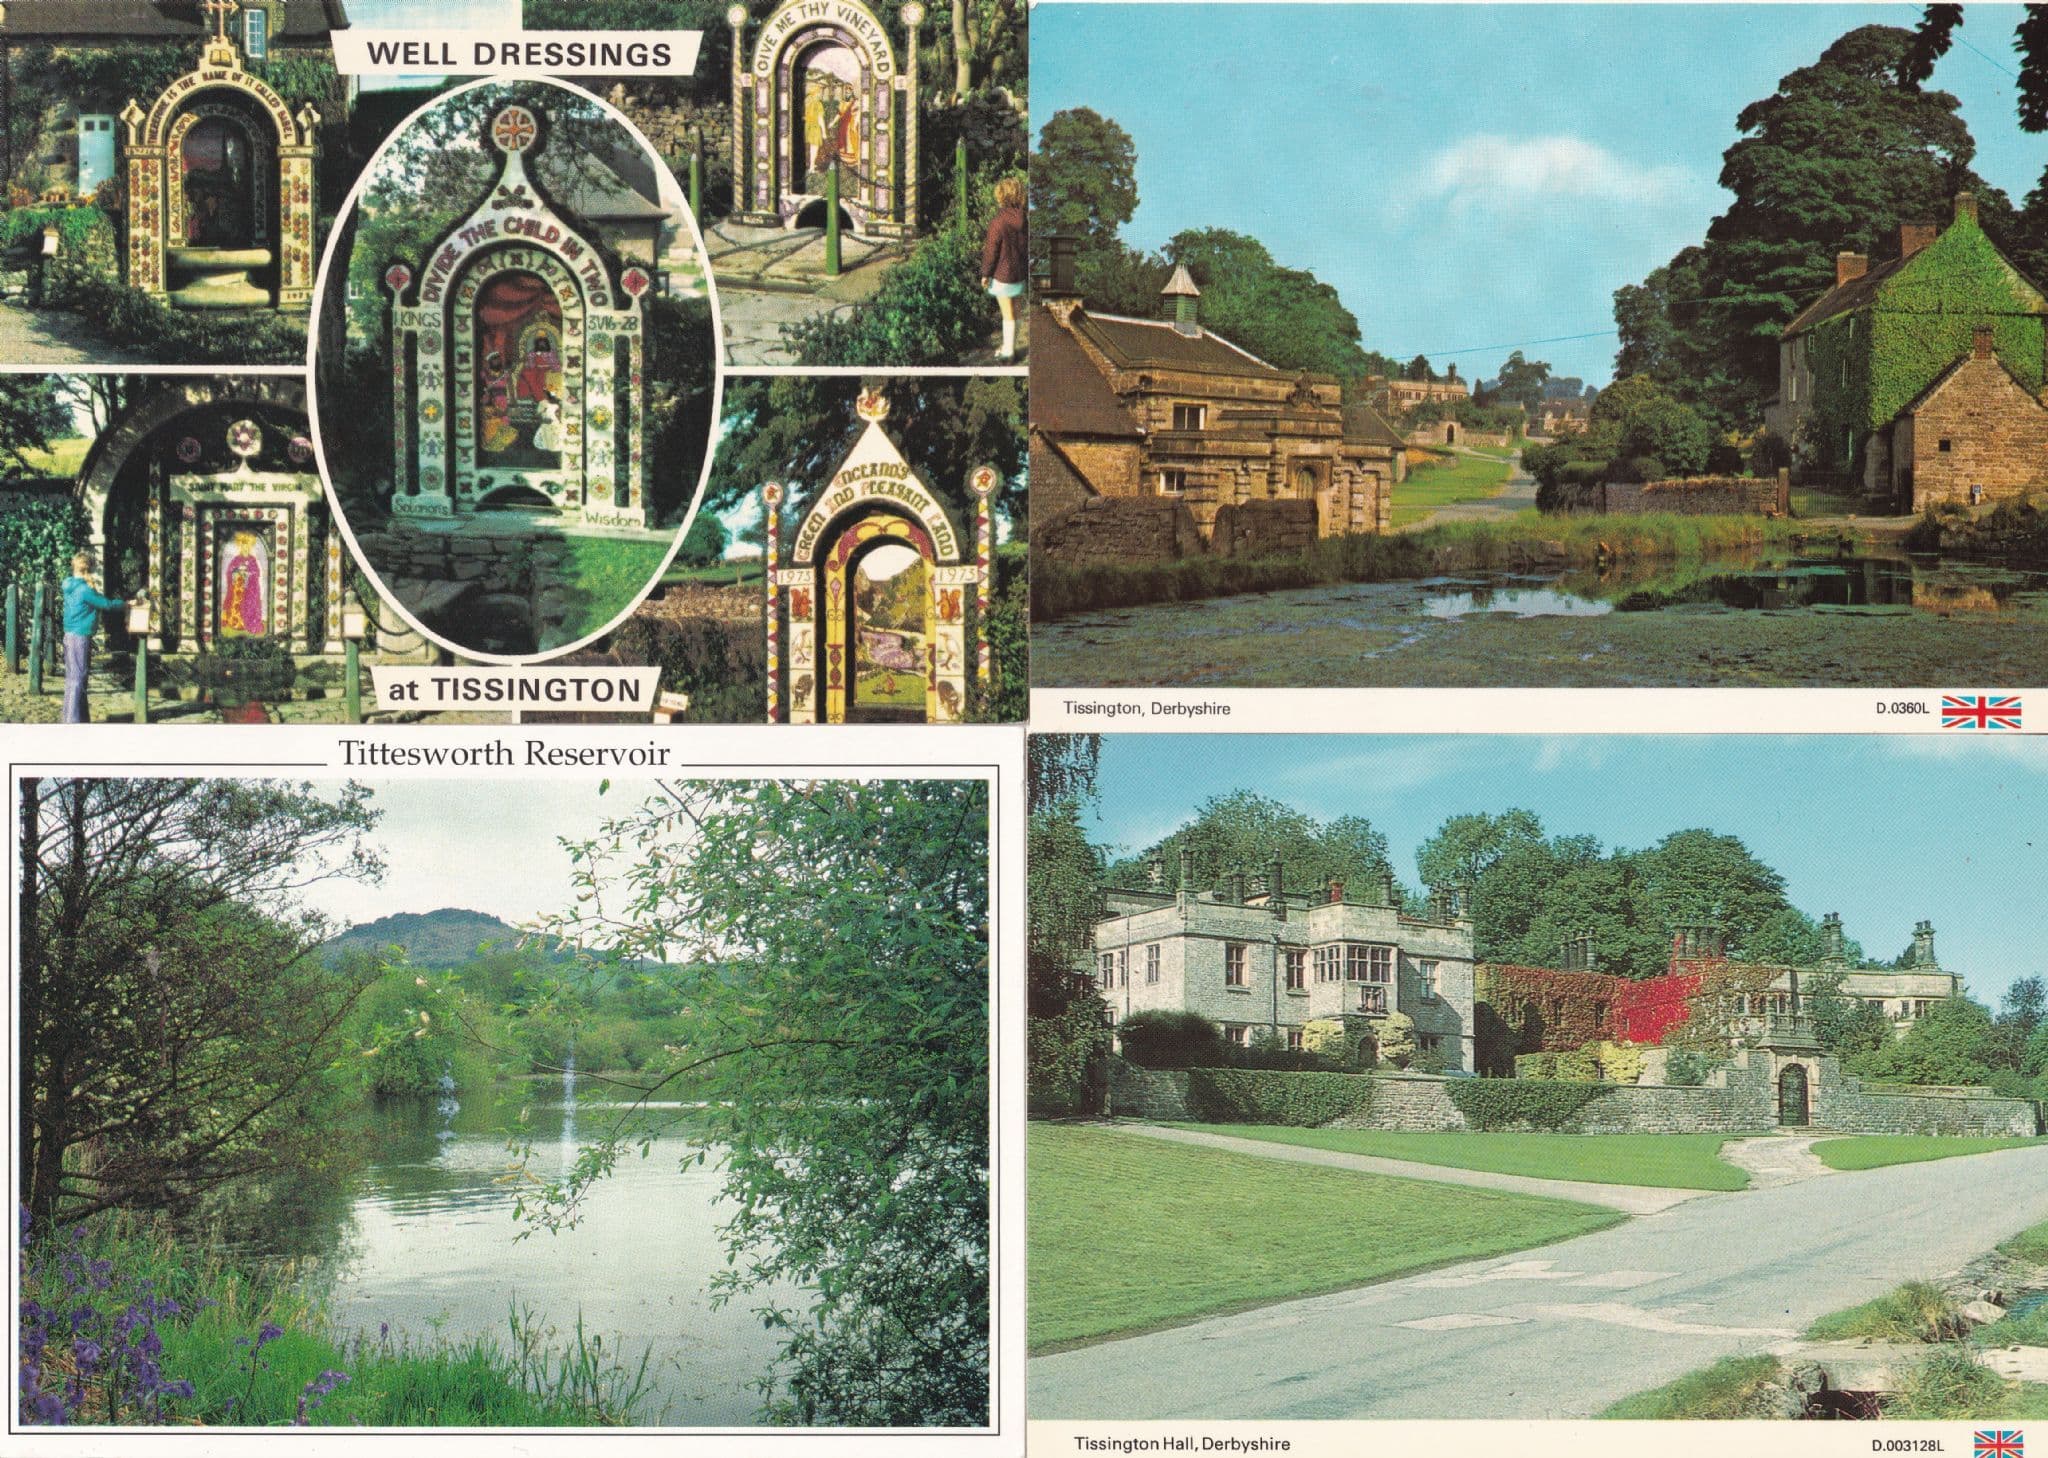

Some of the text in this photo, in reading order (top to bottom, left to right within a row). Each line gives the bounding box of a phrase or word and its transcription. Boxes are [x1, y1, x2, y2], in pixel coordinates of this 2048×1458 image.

[775, 12, 796, 34] ME
[799, 2, 829, 18] THY
[836, 5, 890, 73] VINEYARD
[367, 42, 672, 67] WELL DRESSINGS
[177, 76, 196, 91] THE
[232, 73, 244, 81] OF
[422, 216, 608, 307] DIVIDE THE CHILD IN TWO
[585, 511, 641, 527] Wisdom
[388, 678, 641, 703] at TISSINGTON
[1063, 700, 1232, 719] Tissington, Derbyshire
[1876, 702, 1930, 714] D.0360L
[338, 740, 671, 766] Tittesworth Reservoir
[1074, 1436, 1291, 1454] Tissington Hall, Derbyshire
[1872, 1439, 1945, 1452] D.003128L
